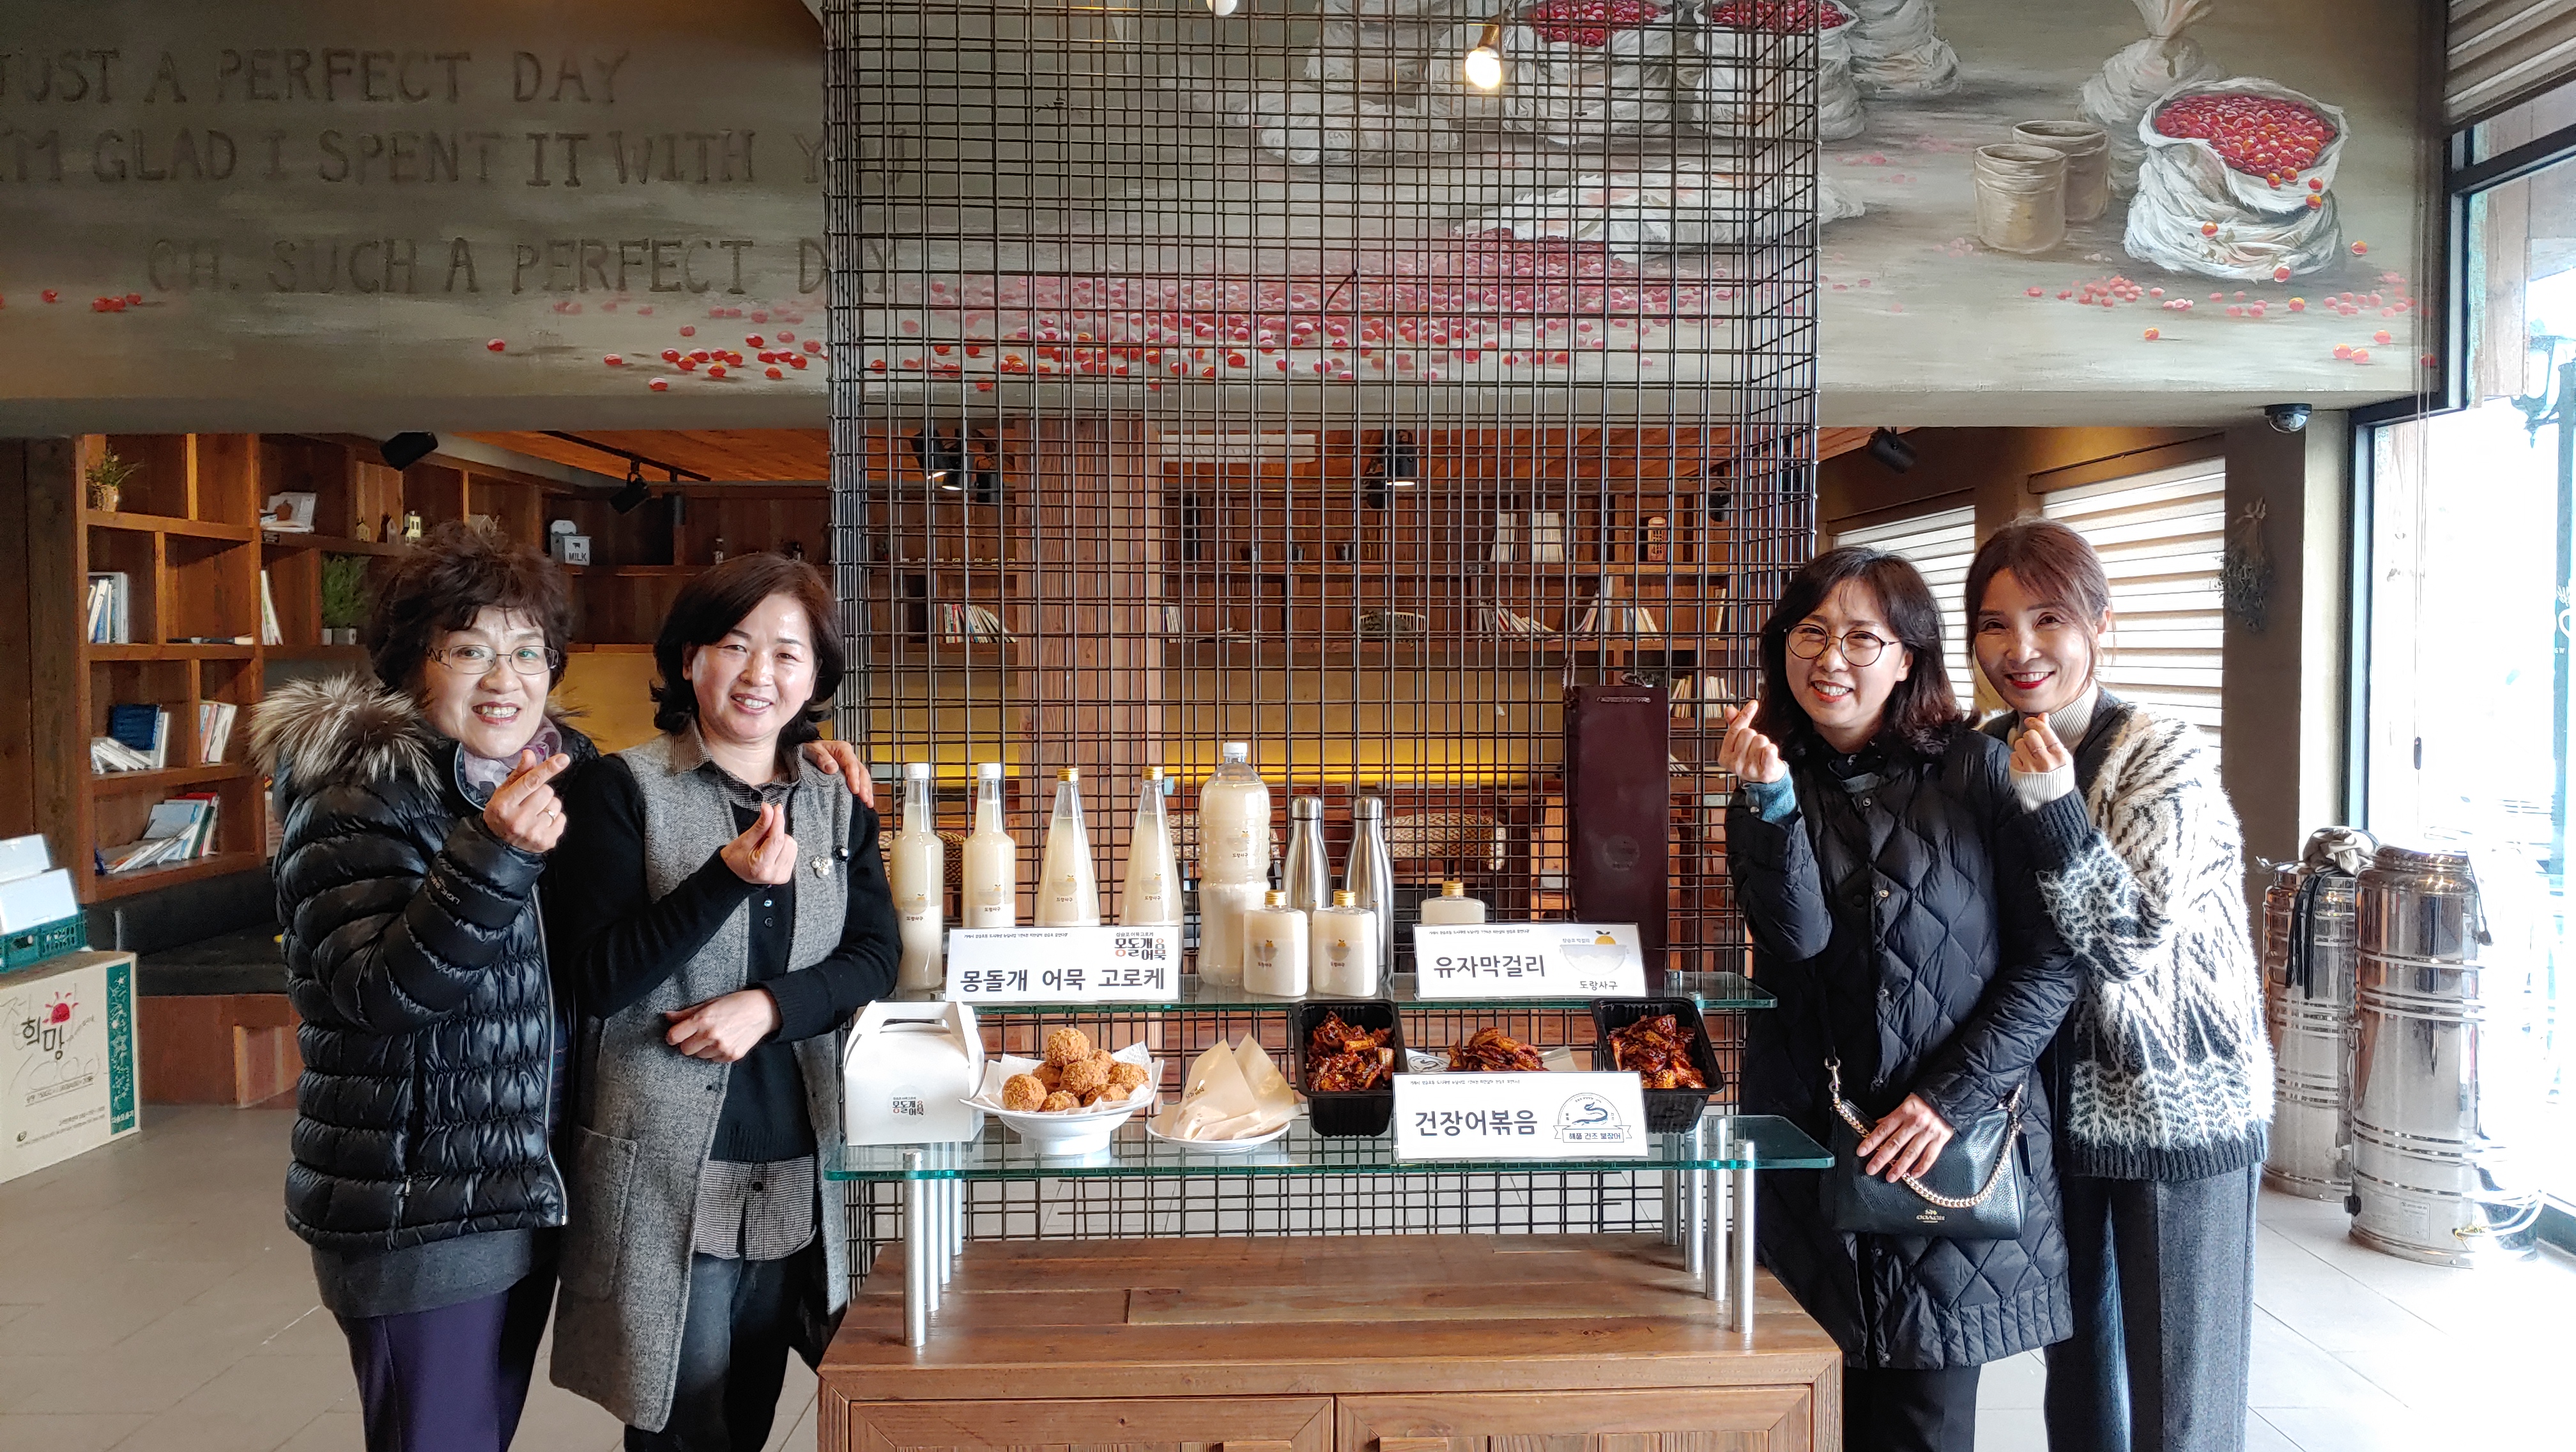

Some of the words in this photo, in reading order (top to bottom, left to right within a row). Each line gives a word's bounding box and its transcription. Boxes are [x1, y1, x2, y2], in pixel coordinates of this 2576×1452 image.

[144, 50, 187, 103] A
[217, 48, 472, 104] PERFECT
[513, 50, 631, 103] DAY
[92, 128, 237, 183] GLAD
[262, 131, 288, 180] I
[319, 128, 501, 185] SPENT
[525, 132, 590, 187] IT
[608, 129, 757, 185] WITH
[791, 128, 907, 185] YU
[266, 238, 418, 294] SUCH
[445, 236, 479, 293] A
[511, 237, 755, 295] PERFECT
[799, 236, 901, 295] DY
[569, 552, 587, 562] MILK
[960, 969, 1027, 992] 몽돌개
[1042, 968, 1086, 991] 어묵
[1098, 968, 1165, 990] 고로케
[1433, 954, 1546, 978] 유자막걸리
[1579, 980, 1618, 991] 도랑사구
[20, 1015, 65, 1061] 희망
[1414, 1109, 1538, 1137] 건장어볶음
